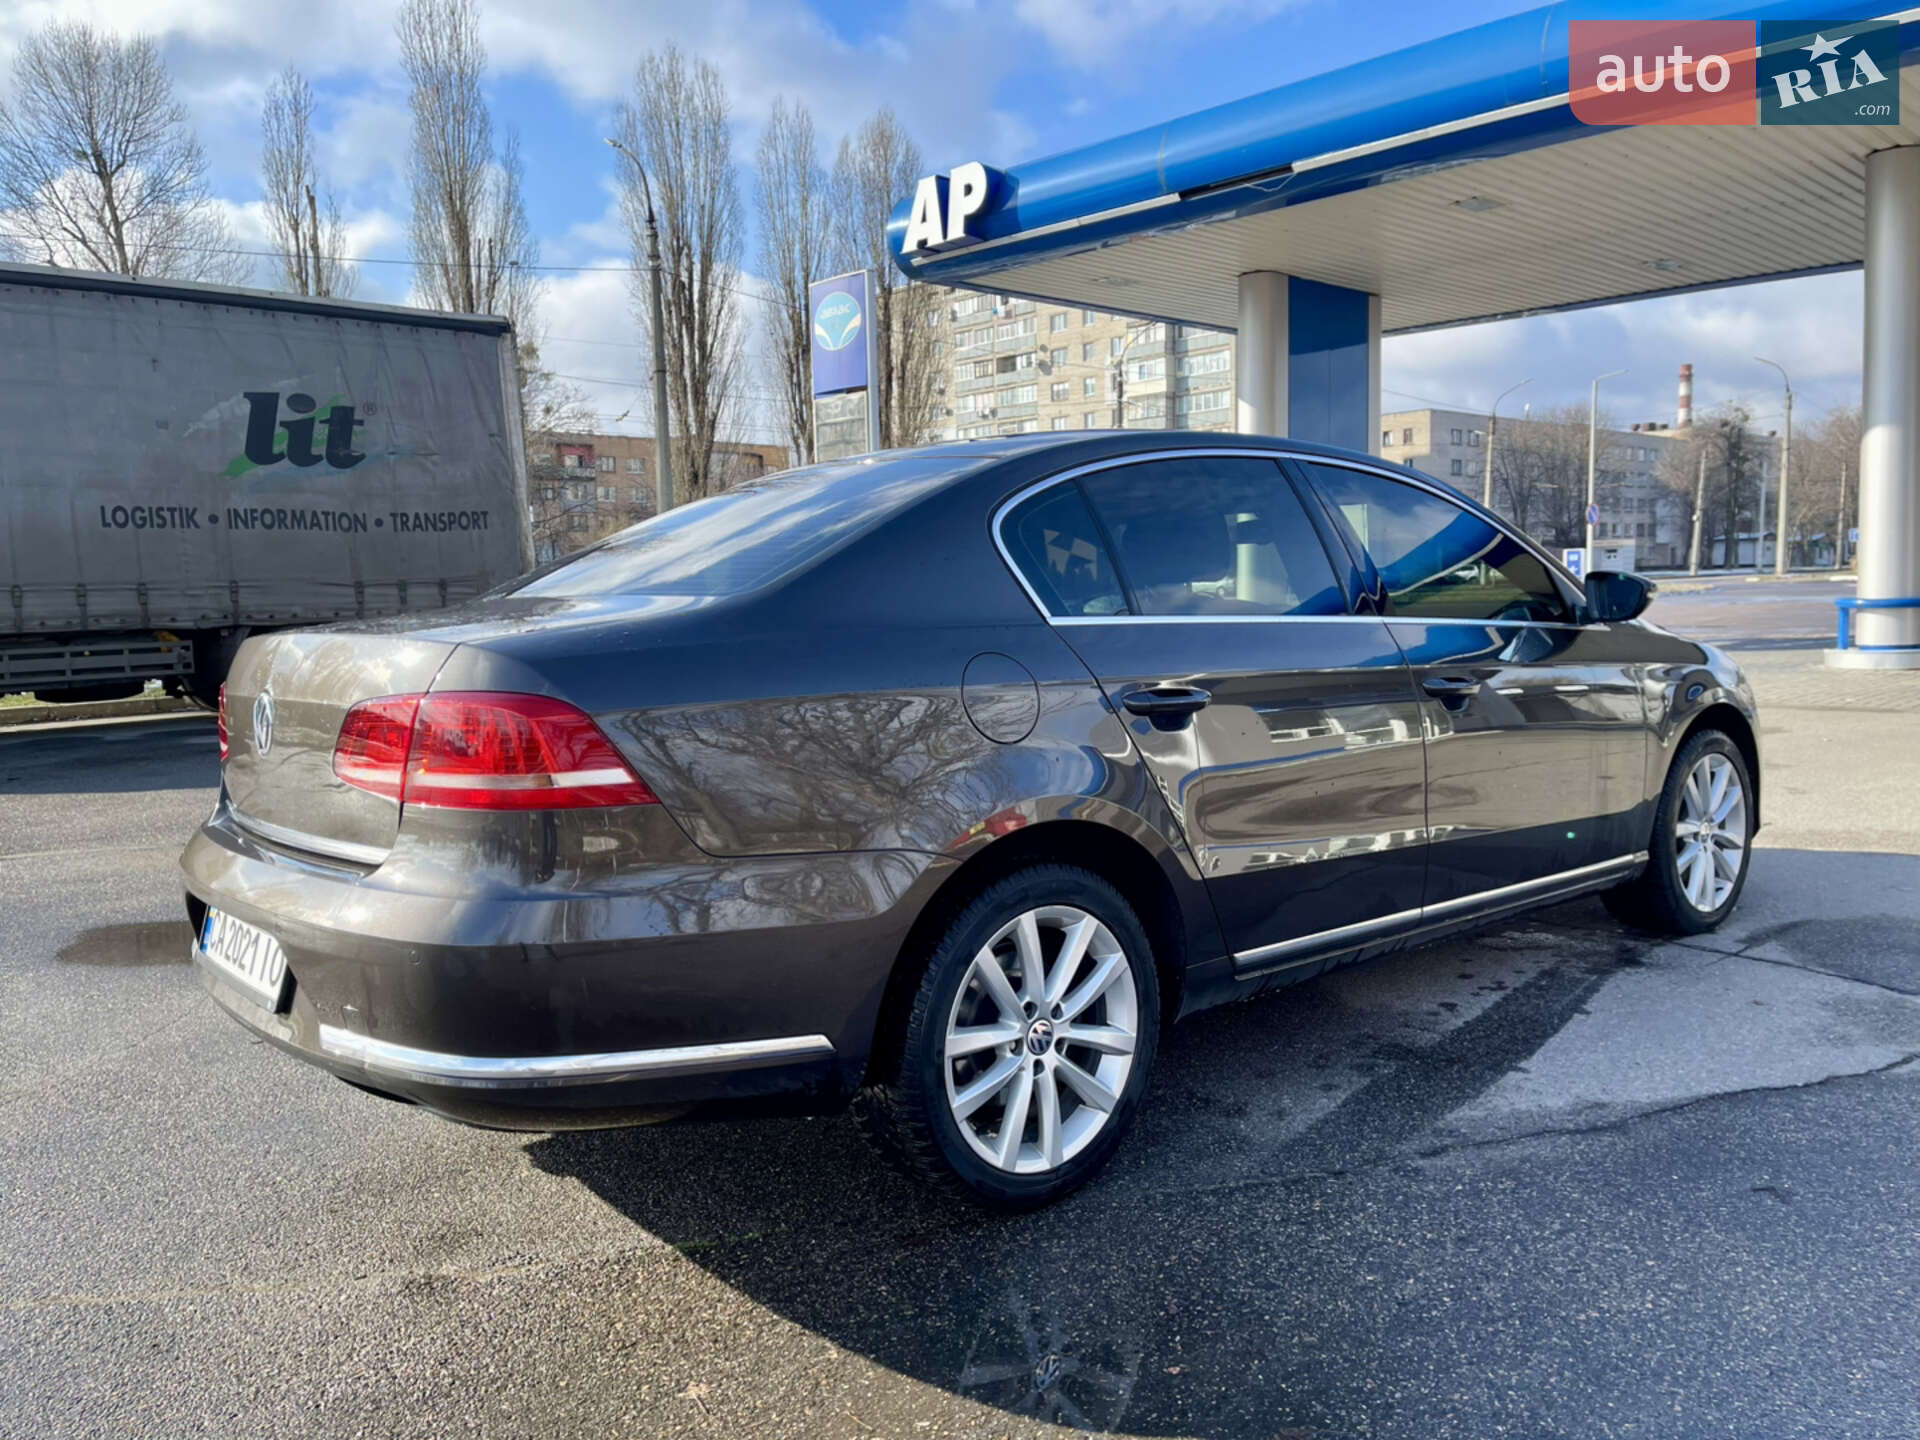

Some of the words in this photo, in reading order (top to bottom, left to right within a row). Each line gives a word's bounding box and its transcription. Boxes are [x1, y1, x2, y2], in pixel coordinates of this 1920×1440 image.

[243, 391, 366, 469] lit
[99, 505, 200, 530] LOGISTIK
[227, 507, 368, 533] INFORMATION
[390, 510, 489, 531] TRANSPORT
